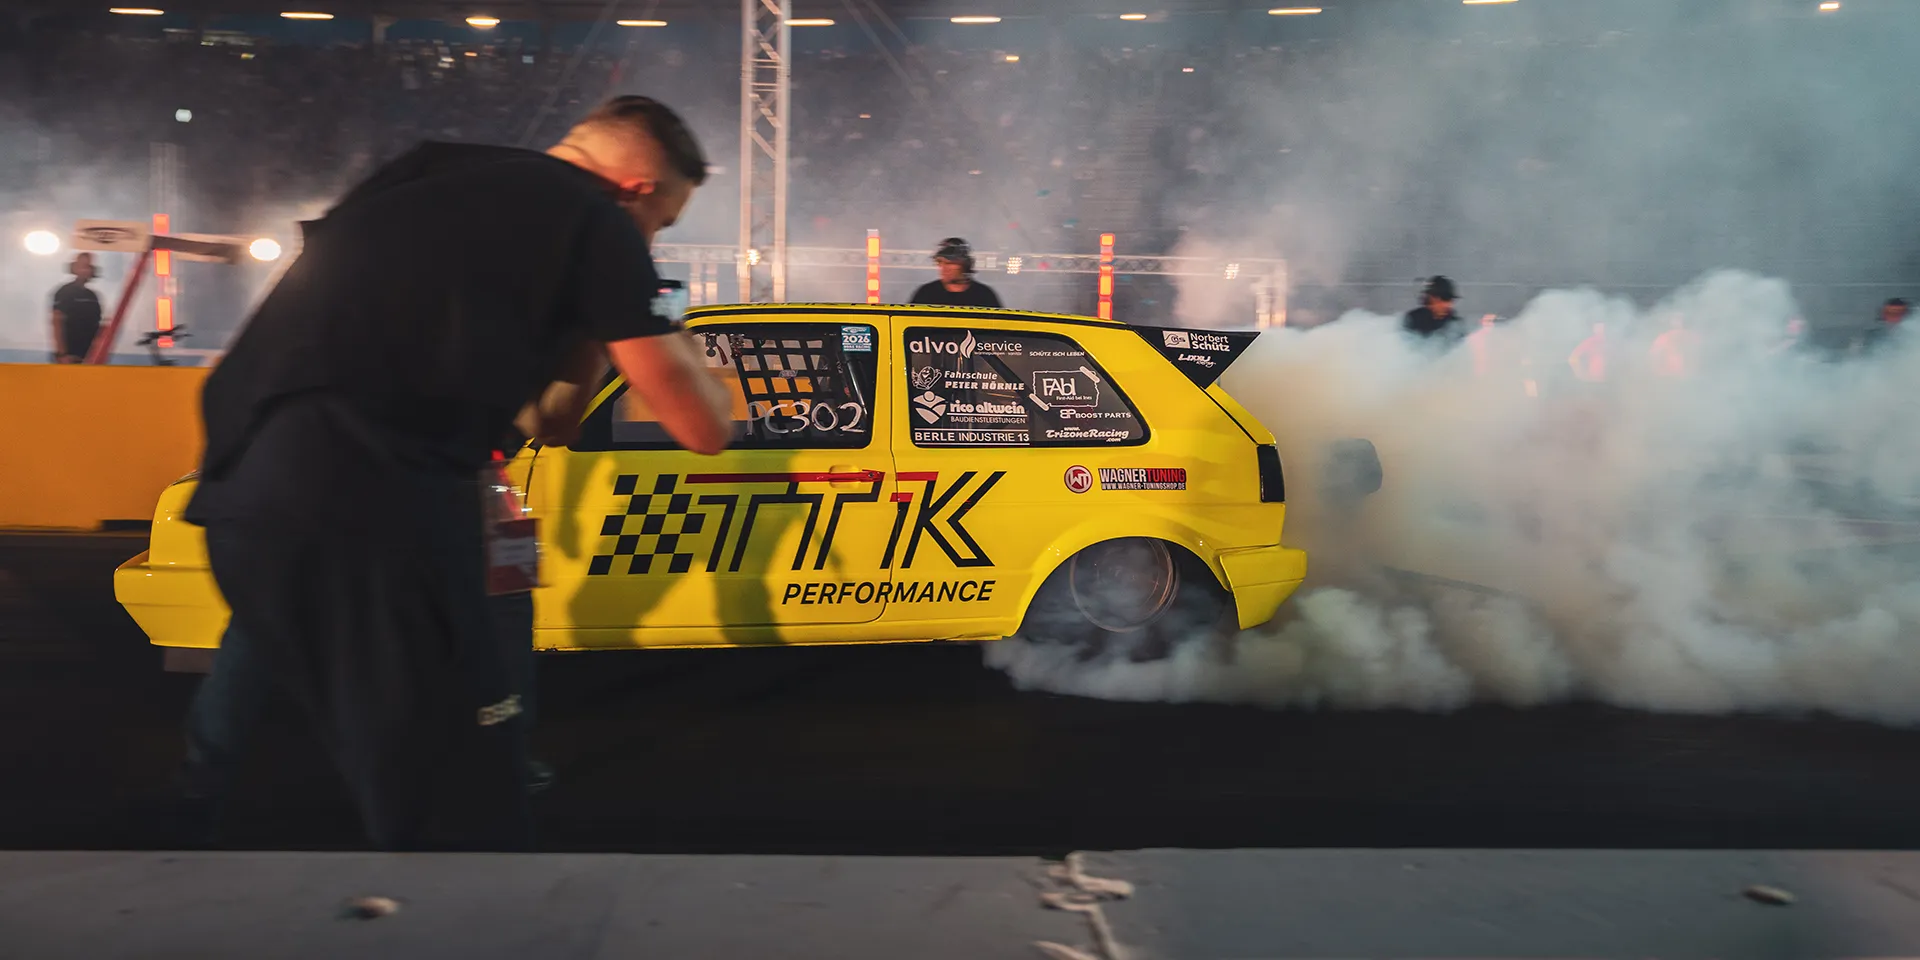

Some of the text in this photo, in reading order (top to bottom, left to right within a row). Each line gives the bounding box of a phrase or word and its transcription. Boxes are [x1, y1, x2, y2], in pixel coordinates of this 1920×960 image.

[843, 335, 870, 343] 2026
[1190, 333, 1229, 344] Norbert
[909, 337, 1023, 355] alvo service
[1192, 341, 1231, 352] Schütz
[944, 370, 998, 380] Fahrschule
[945, 380, 1025, 390] PETER HÖRNLE
[950, 400, 1025, 414] rico altwein
[745, 401, 865, 435] PC302
[951, 416, 1026, 424] BAUDIENSTLEISTUNGEN
[914, 432, 1030, 442] BERLE INDUSTRIE 13
[1046, 429, 1130, 440] TrizoneRacing
[1101, 482, 1186, 490] WWW.WAGNER-TUNINGSHOP.DE
[781, 580, 996, 605] PERFORMANCE
